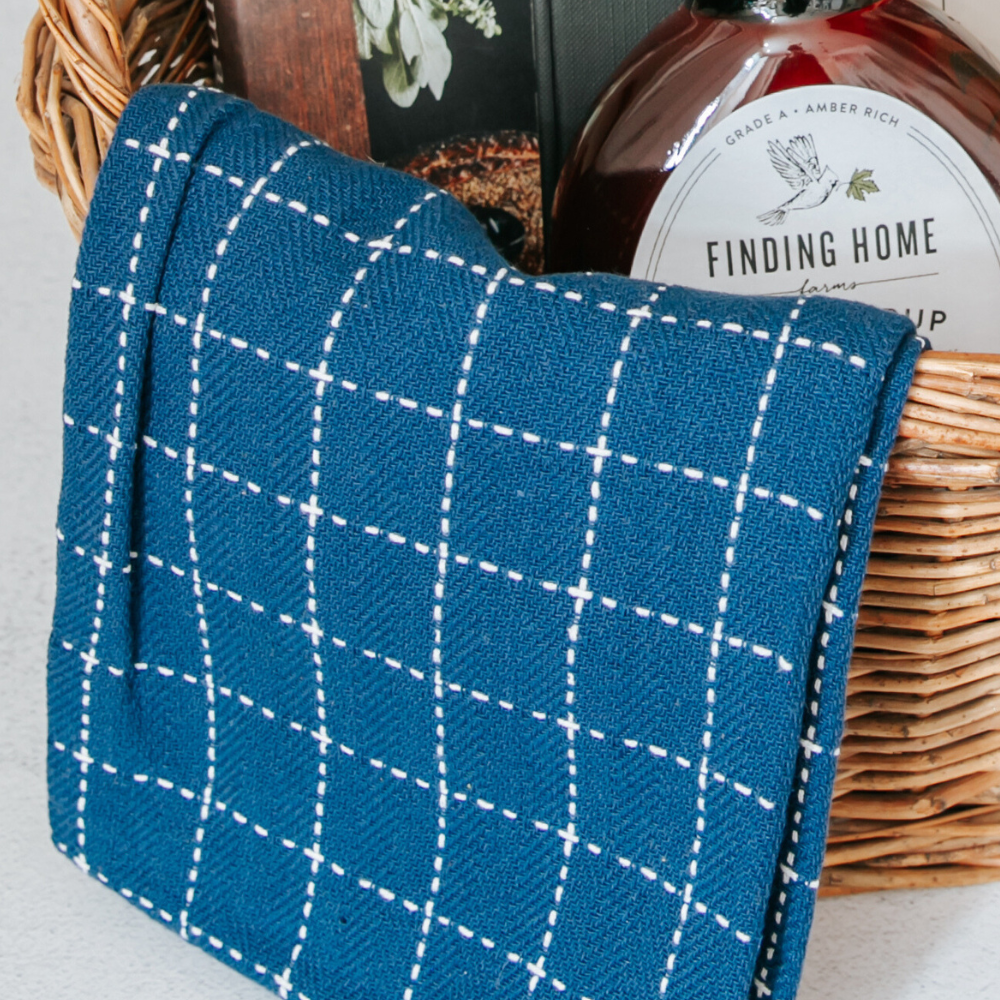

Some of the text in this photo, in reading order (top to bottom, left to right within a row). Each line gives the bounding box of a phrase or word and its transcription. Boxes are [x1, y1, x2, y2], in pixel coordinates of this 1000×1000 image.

[725, 102, 900, 146] GRADE A AMBER RICH
[706, 218, 937, 278] FINDING HOME
[799, 278, 857, 295] farms
